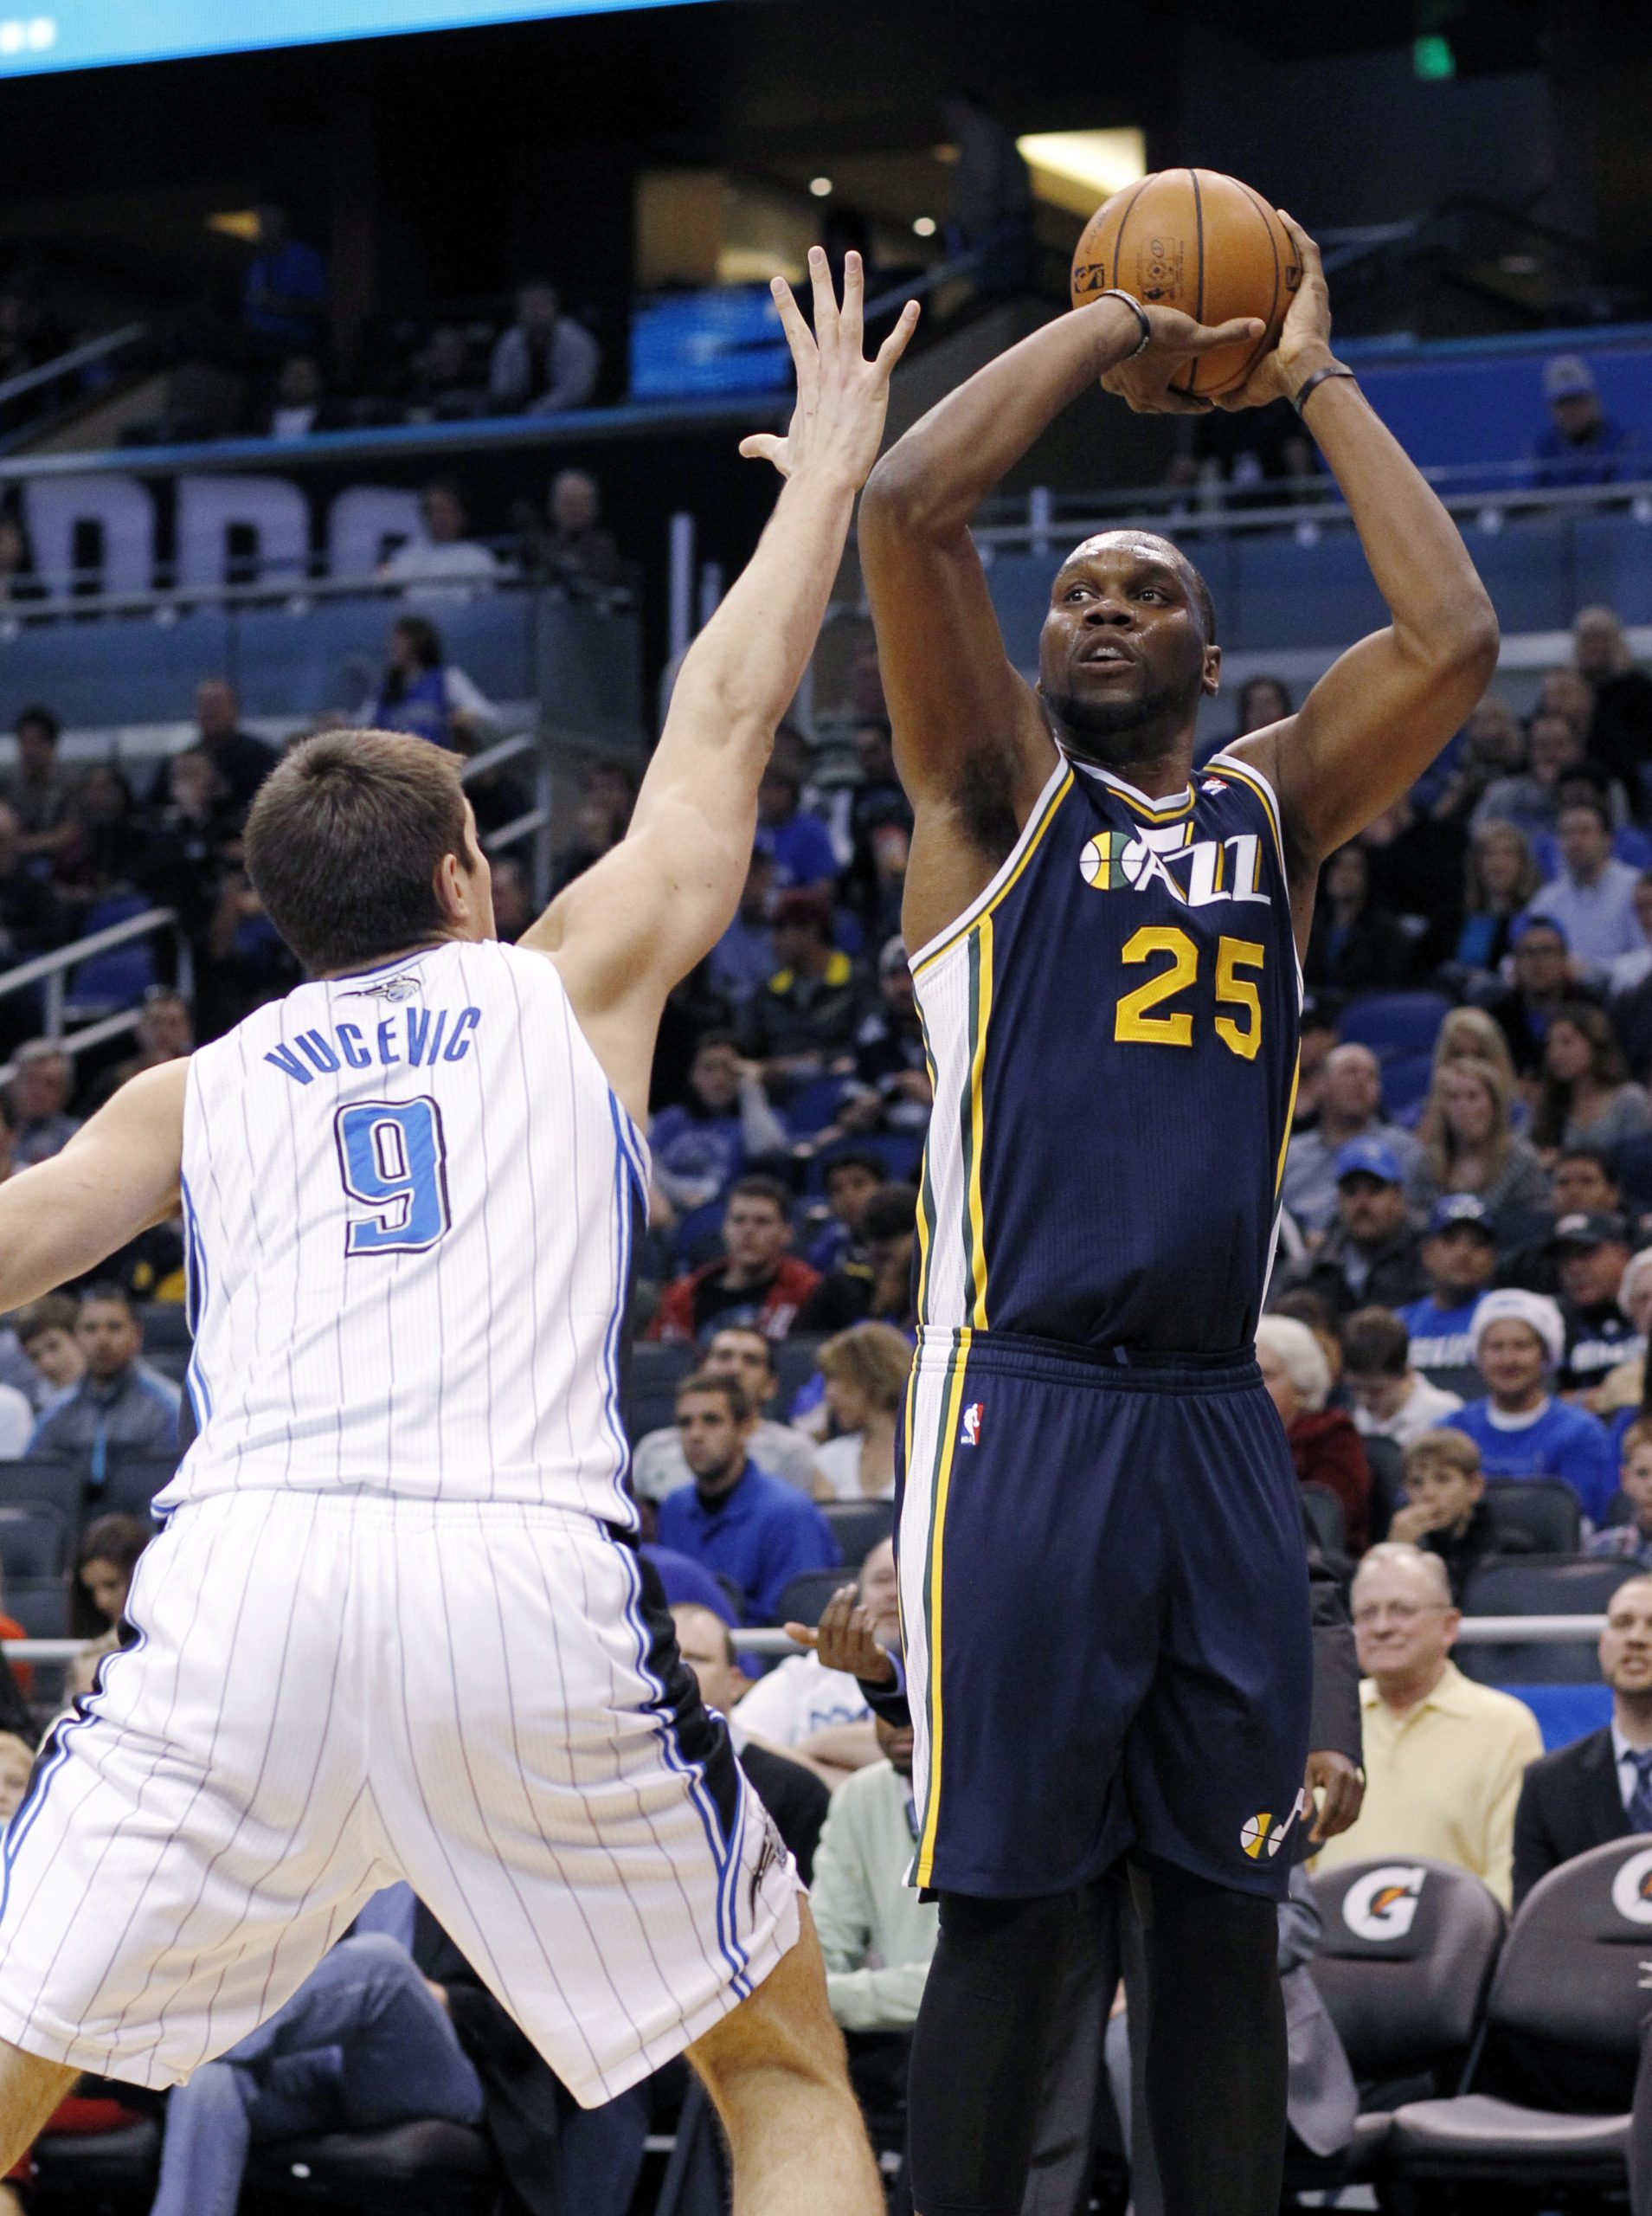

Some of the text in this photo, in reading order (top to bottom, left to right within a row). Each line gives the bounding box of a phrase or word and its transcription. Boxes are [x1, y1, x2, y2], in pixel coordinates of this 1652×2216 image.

[263, 1007, 482, 1085] VUCEVIC
[1115, 926, 1264, 1060] 25
[333, 1094, 451, 1259] 9
[1342, 1866, 1427, 1941] G
